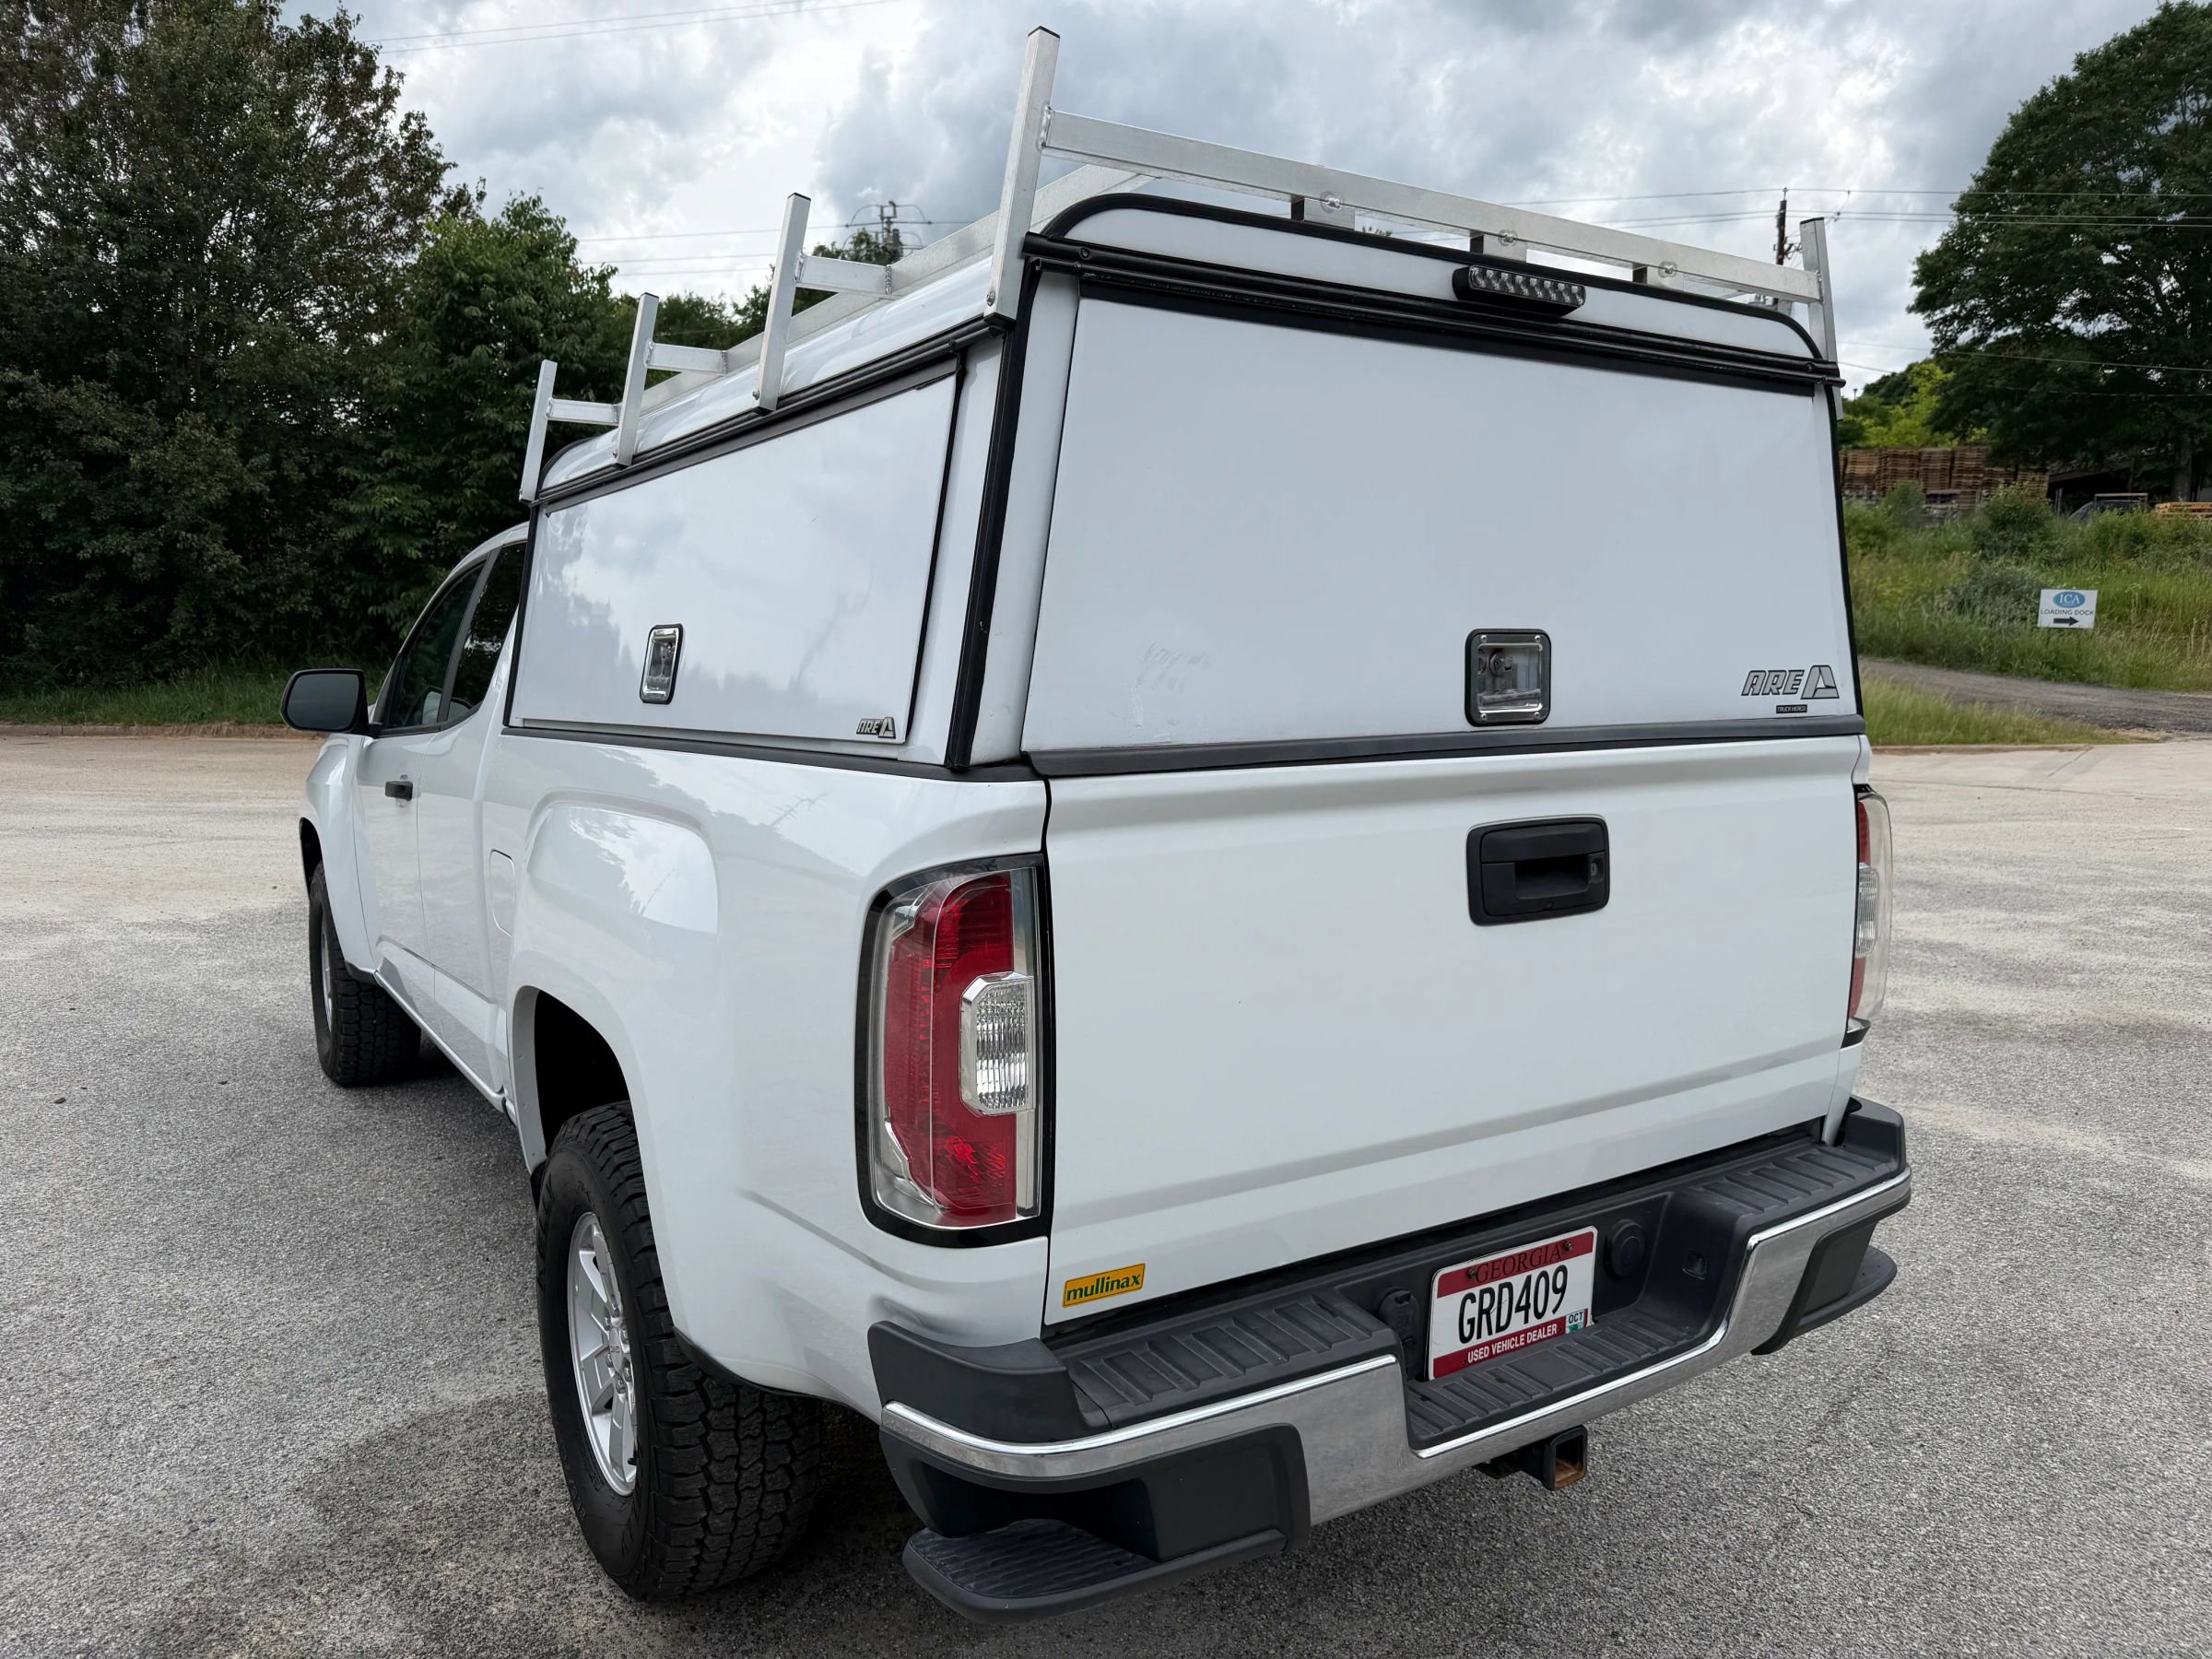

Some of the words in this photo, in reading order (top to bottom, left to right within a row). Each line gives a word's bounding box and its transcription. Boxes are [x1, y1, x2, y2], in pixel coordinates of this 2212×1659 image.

[2059, 594, 2080, 604] ICA
[1476, 1244, 1563, 1284] GEORGIA
[1066, 1274, 1141, 1301] mullinax
[1458, 1265, 1569, 1344] GRD409
[1569, 1311, 1583, 1324] OCT
[1467, 1347, 1489, 1363] USED
[1491, 1334, 1525, 1355] VEHICLE
[1526, 1323, 1558, 1344] DEALER
